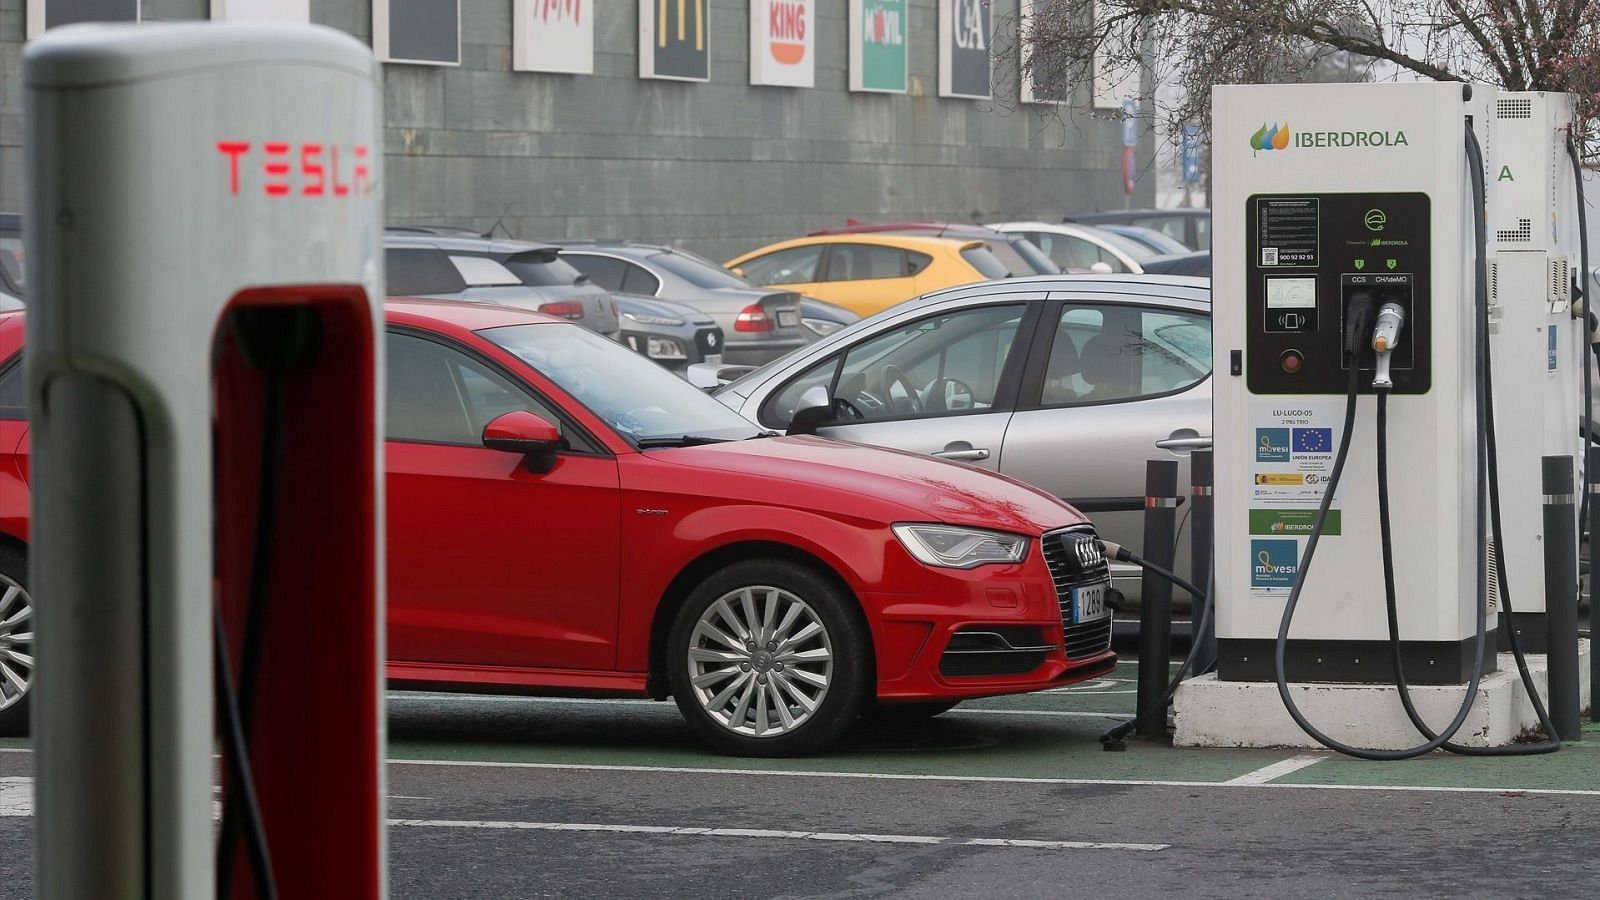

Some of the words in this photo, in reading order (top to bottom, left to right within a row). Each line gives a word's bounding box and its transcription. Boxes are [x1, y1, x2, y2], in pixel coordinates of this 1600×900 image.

[770, 1, 805, 40] KING
[1295, 131, 1409, 148] IBERDROLA
[1497, 165, 1514, 182] A
[1081, 588, 1101, 616] 1289
